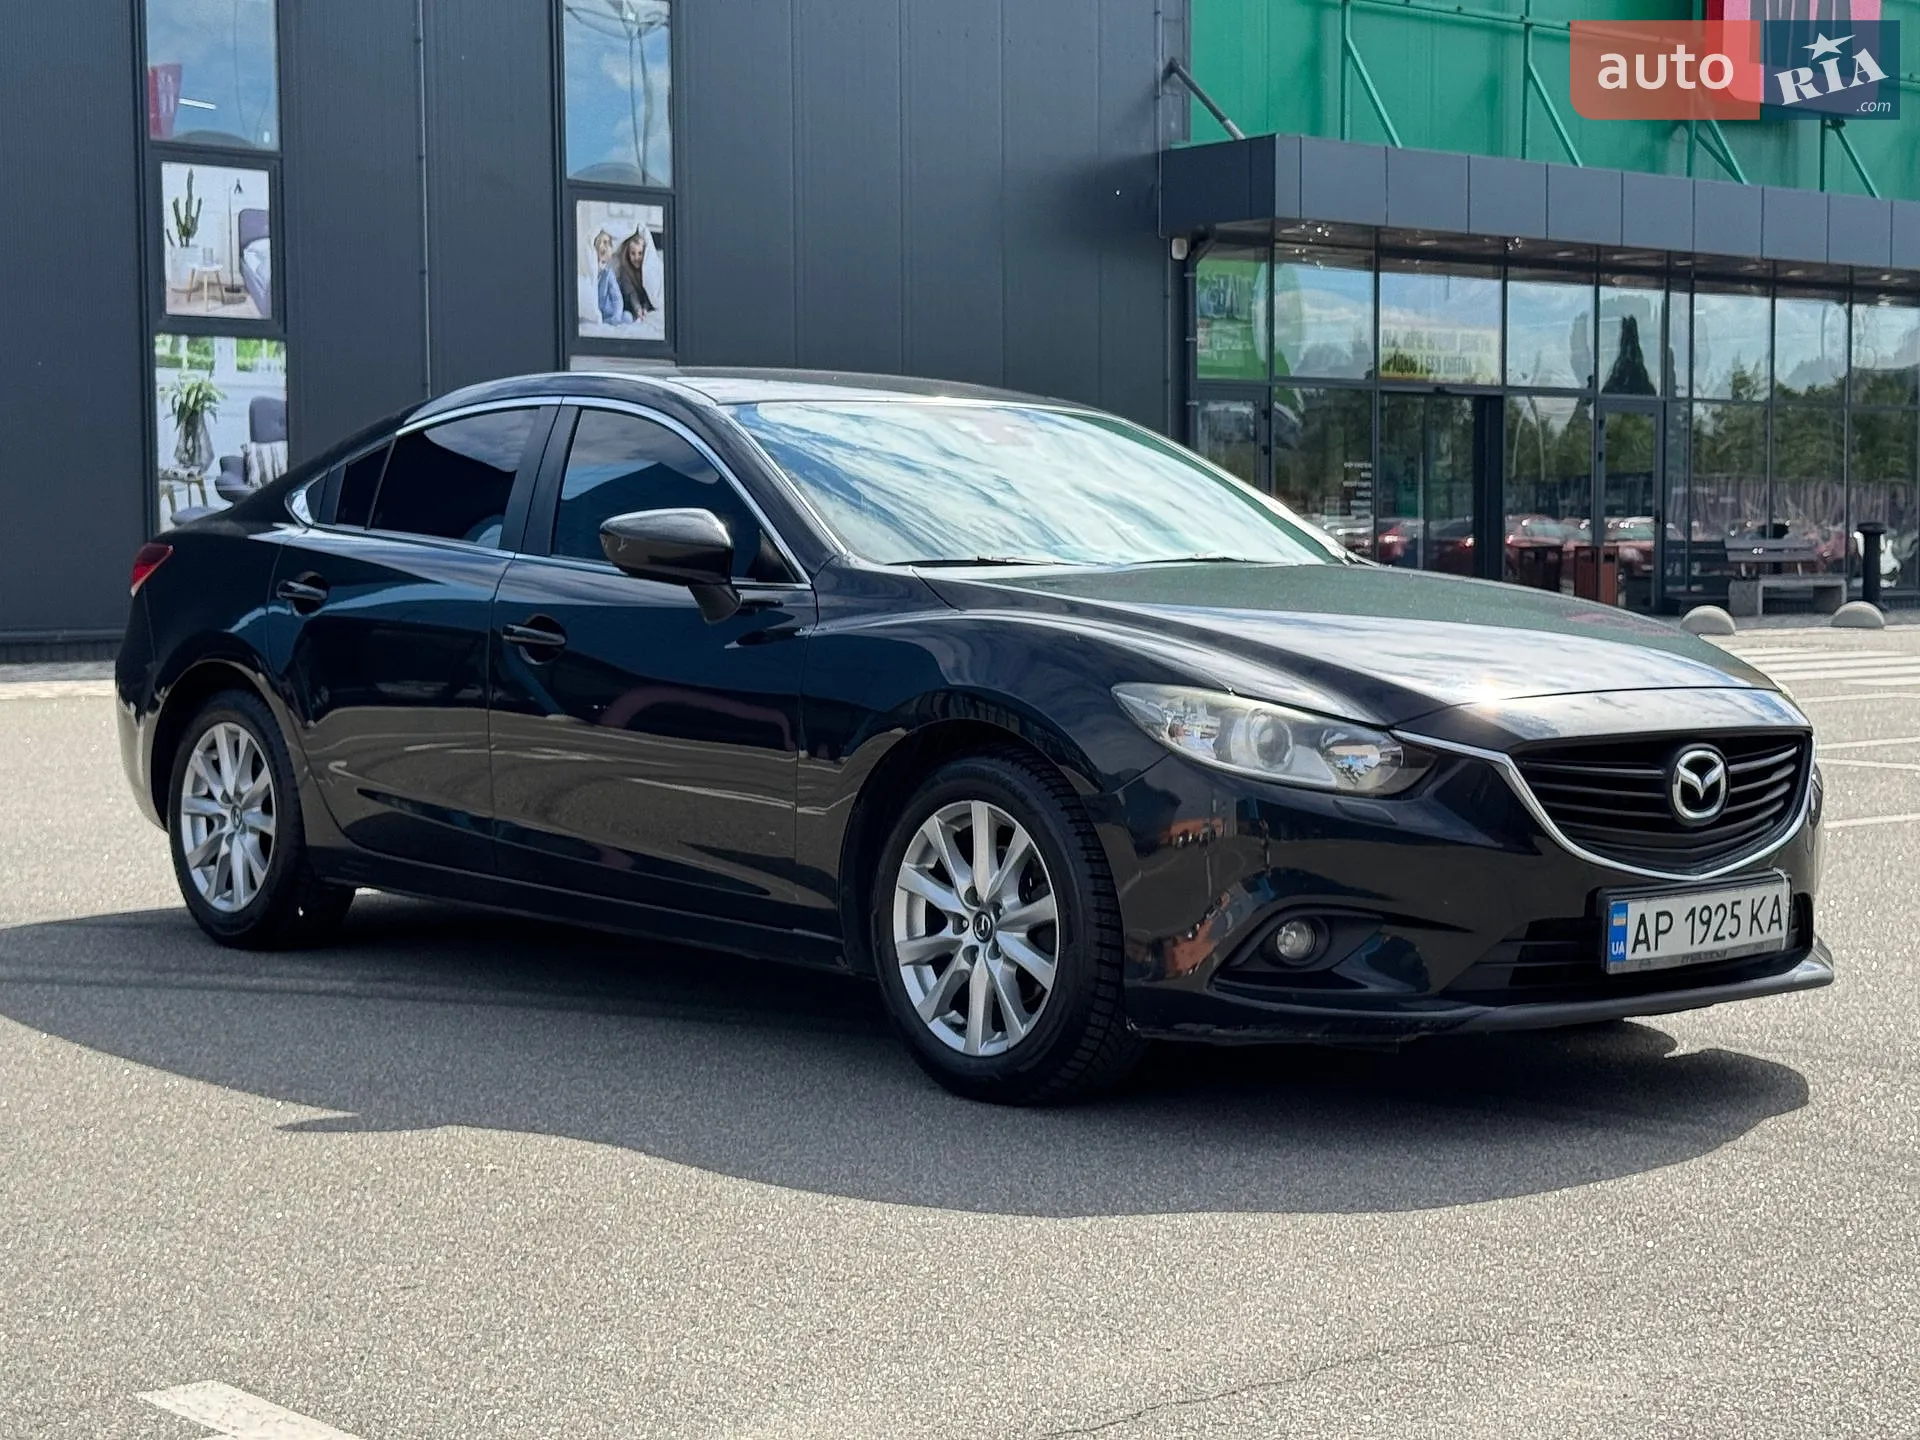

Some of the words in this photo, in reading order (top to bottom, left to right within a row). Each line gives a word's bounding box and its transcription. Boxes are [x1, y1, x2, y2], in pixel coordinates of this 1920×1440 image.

[1631, 910, 1674, 954] AP
[1684, 899, 1742, 947] 1925
[1749, 894, 1783, 937] KA
[1610, 942, 1625, 956] UA
